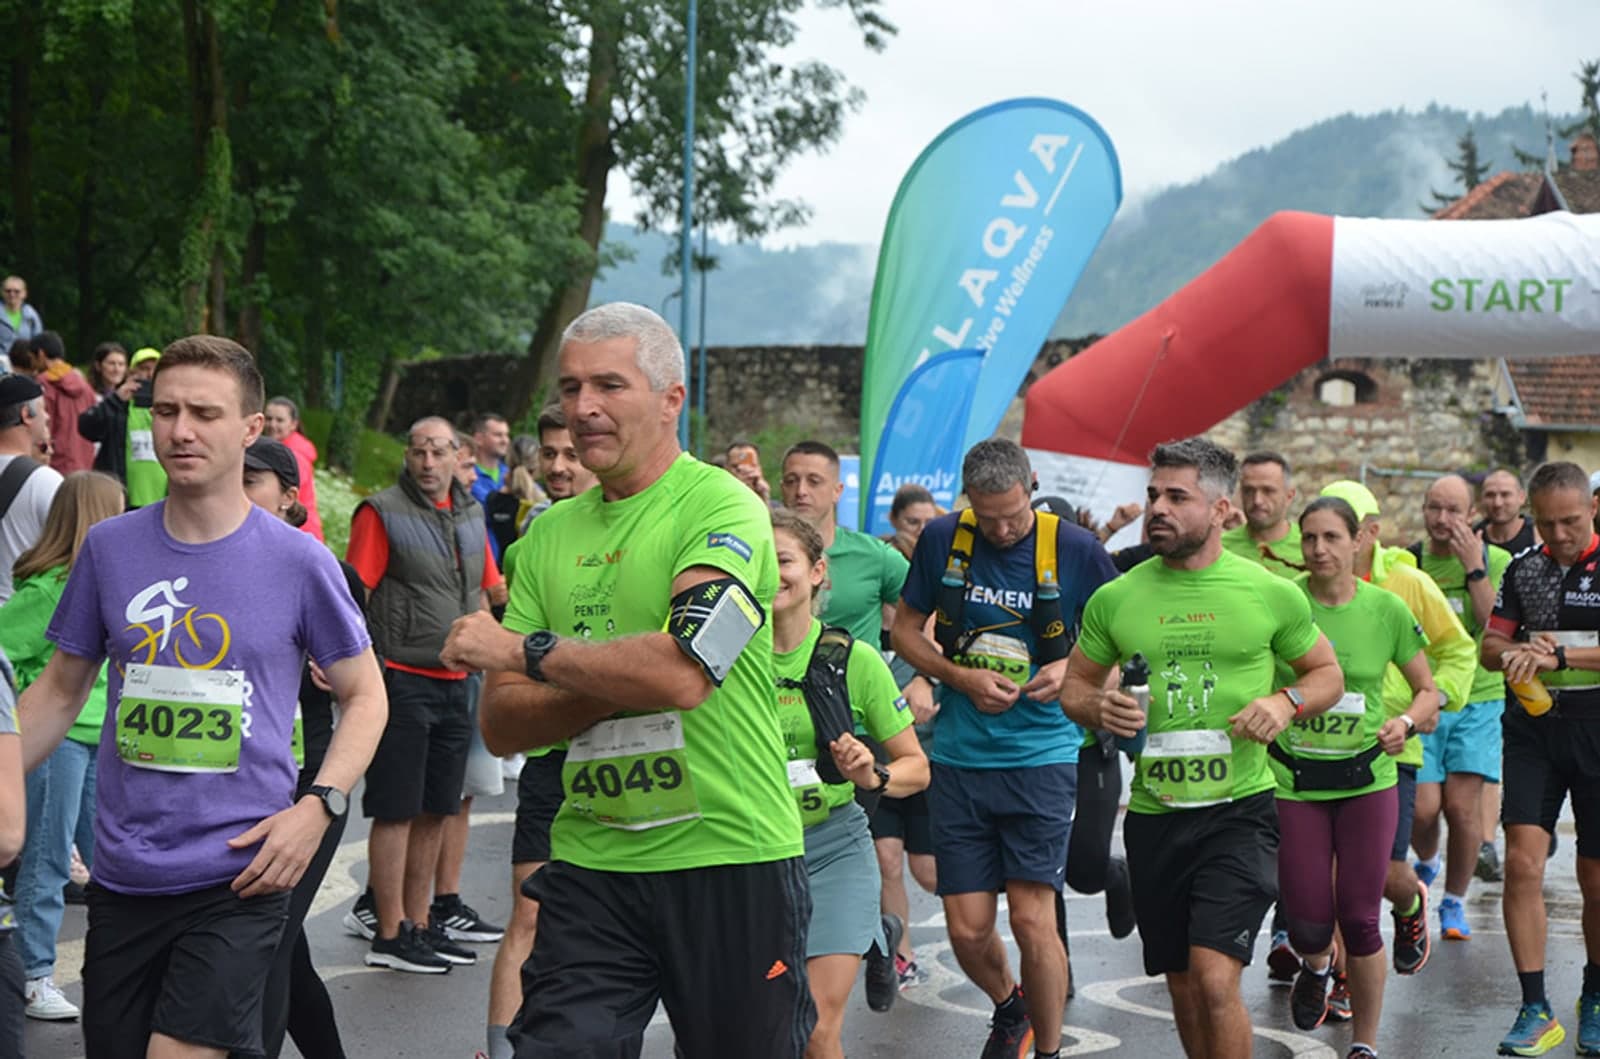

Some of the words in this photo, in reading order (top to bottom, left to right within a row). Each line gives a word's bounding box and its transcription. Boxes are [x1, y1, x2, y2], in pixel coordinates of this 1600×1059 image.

[994, 223, 1055, 318] Wellness
[1429, 277, 1573, 313] START
[123, 703, 233, 741] 4023
[1293, 715, 1361, 736] 4027
[571, 756, 683, 798] 4049
[1147, 758, 1228, 784] 4030
